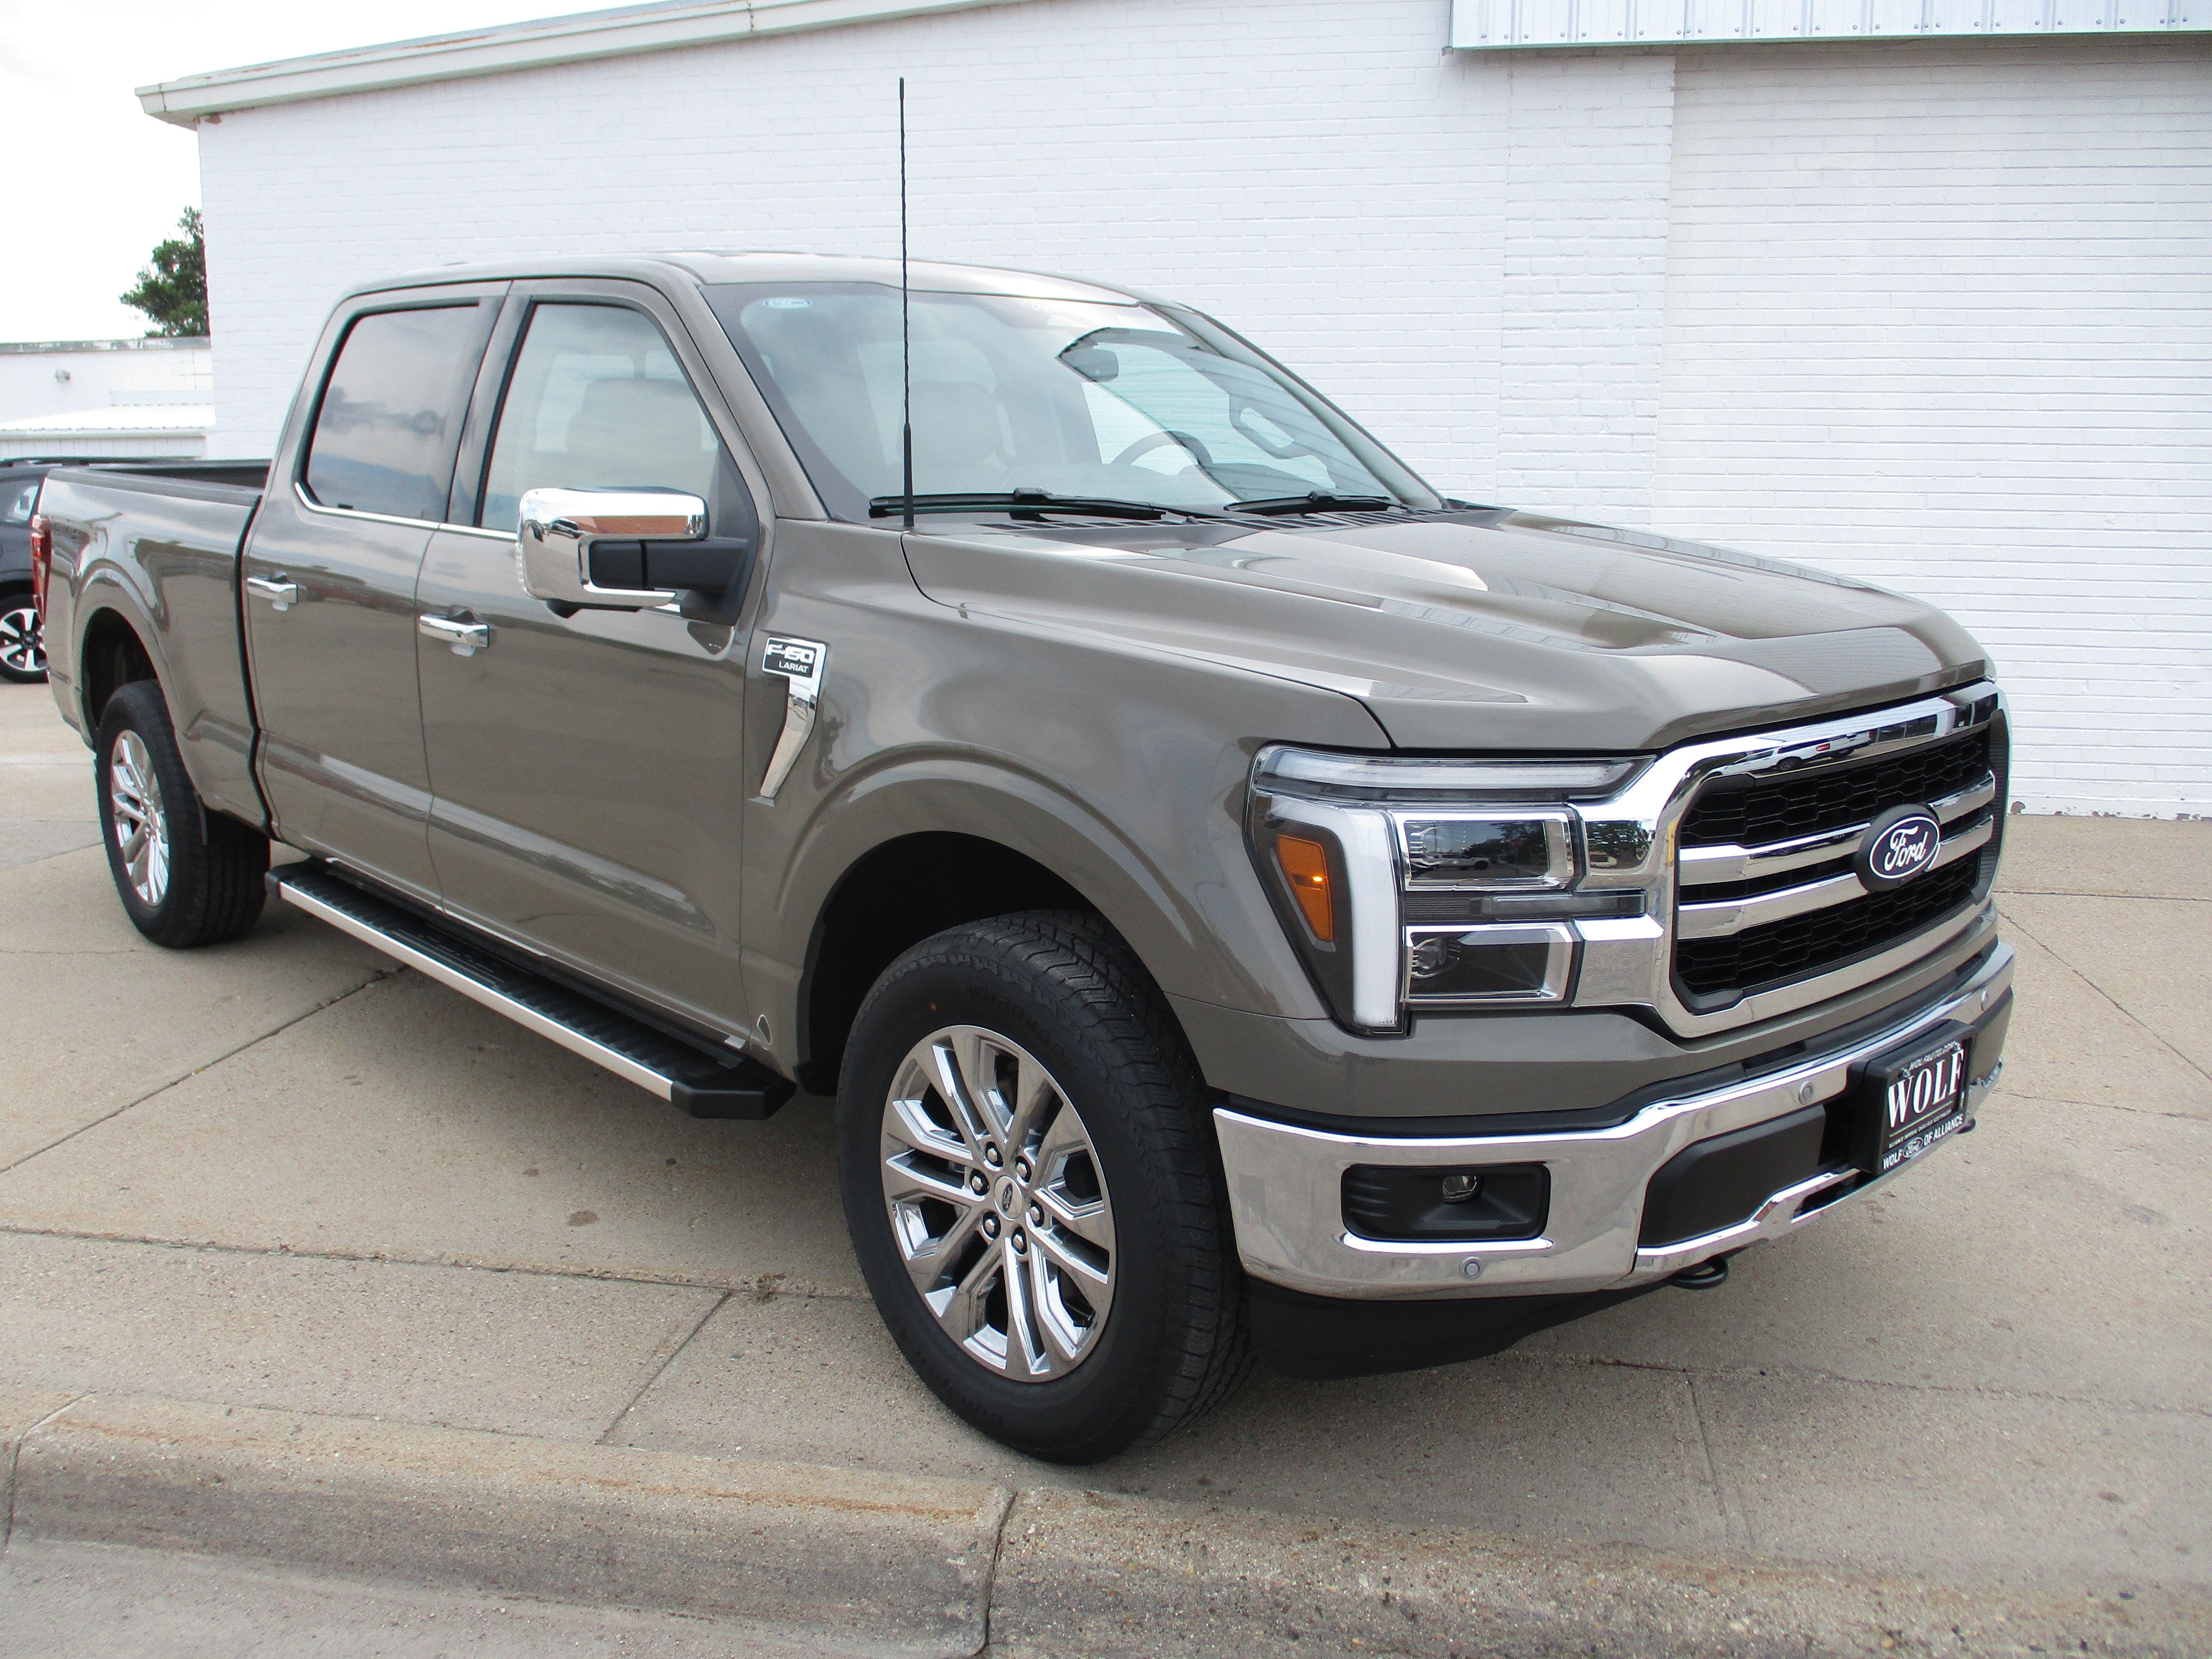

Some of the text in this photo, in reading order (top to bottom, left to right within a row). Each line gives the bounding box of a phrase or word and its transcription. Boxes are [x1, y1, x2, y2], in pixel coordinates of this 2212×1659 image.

[766, 644, 815, 664] F-150
[778, 660, 809, 673] LARIAT
[1884, 826, 1929, 871] Ford
[1888, 1048, 1964, 1128] WOLF
[1883, 1149, 1903, 1170] WOLF
[1924, 1132, 1934, 1146] OF
[1933, 1113, 1964, 1141] ALLIANCE
